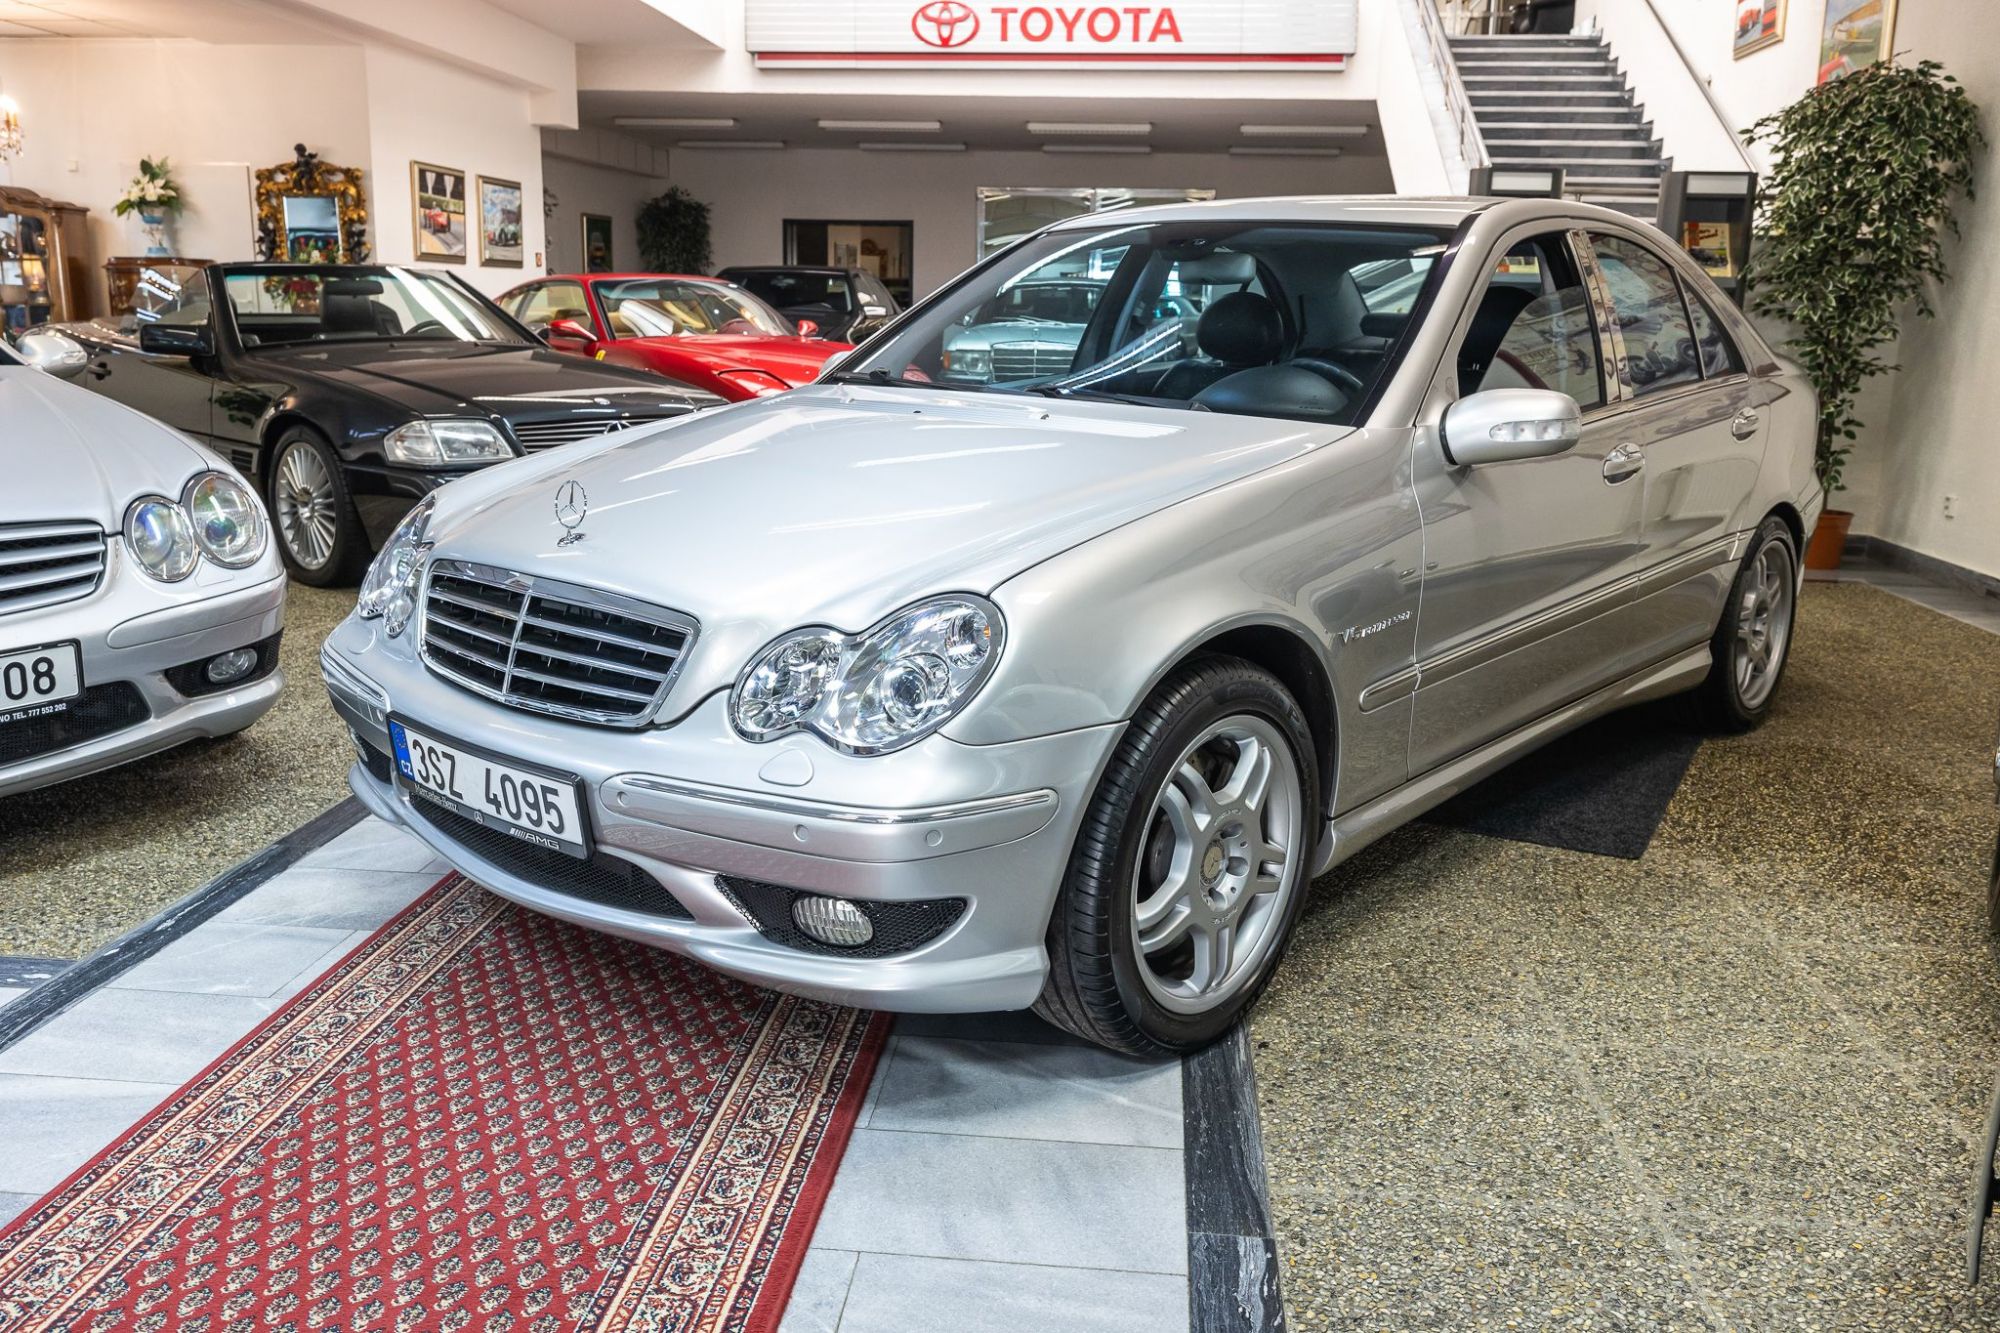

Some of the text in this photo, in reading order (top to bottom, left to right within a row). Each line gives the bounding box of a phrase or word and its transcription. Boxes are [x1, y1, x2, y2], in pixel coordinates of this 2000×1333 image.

[991, 7, 1184, 43] TOYOTA
[0, 656, 56, 701] 08
[12, 710, 27, 721] TEL.
[28, 707, 40, 718] 777
[41, 704, 54, 715] 552
[400, 759, 413, 776] CZ
[412, 739, 565, 835] 3SZ 4095
[525, 832, 560, 850] AMG
